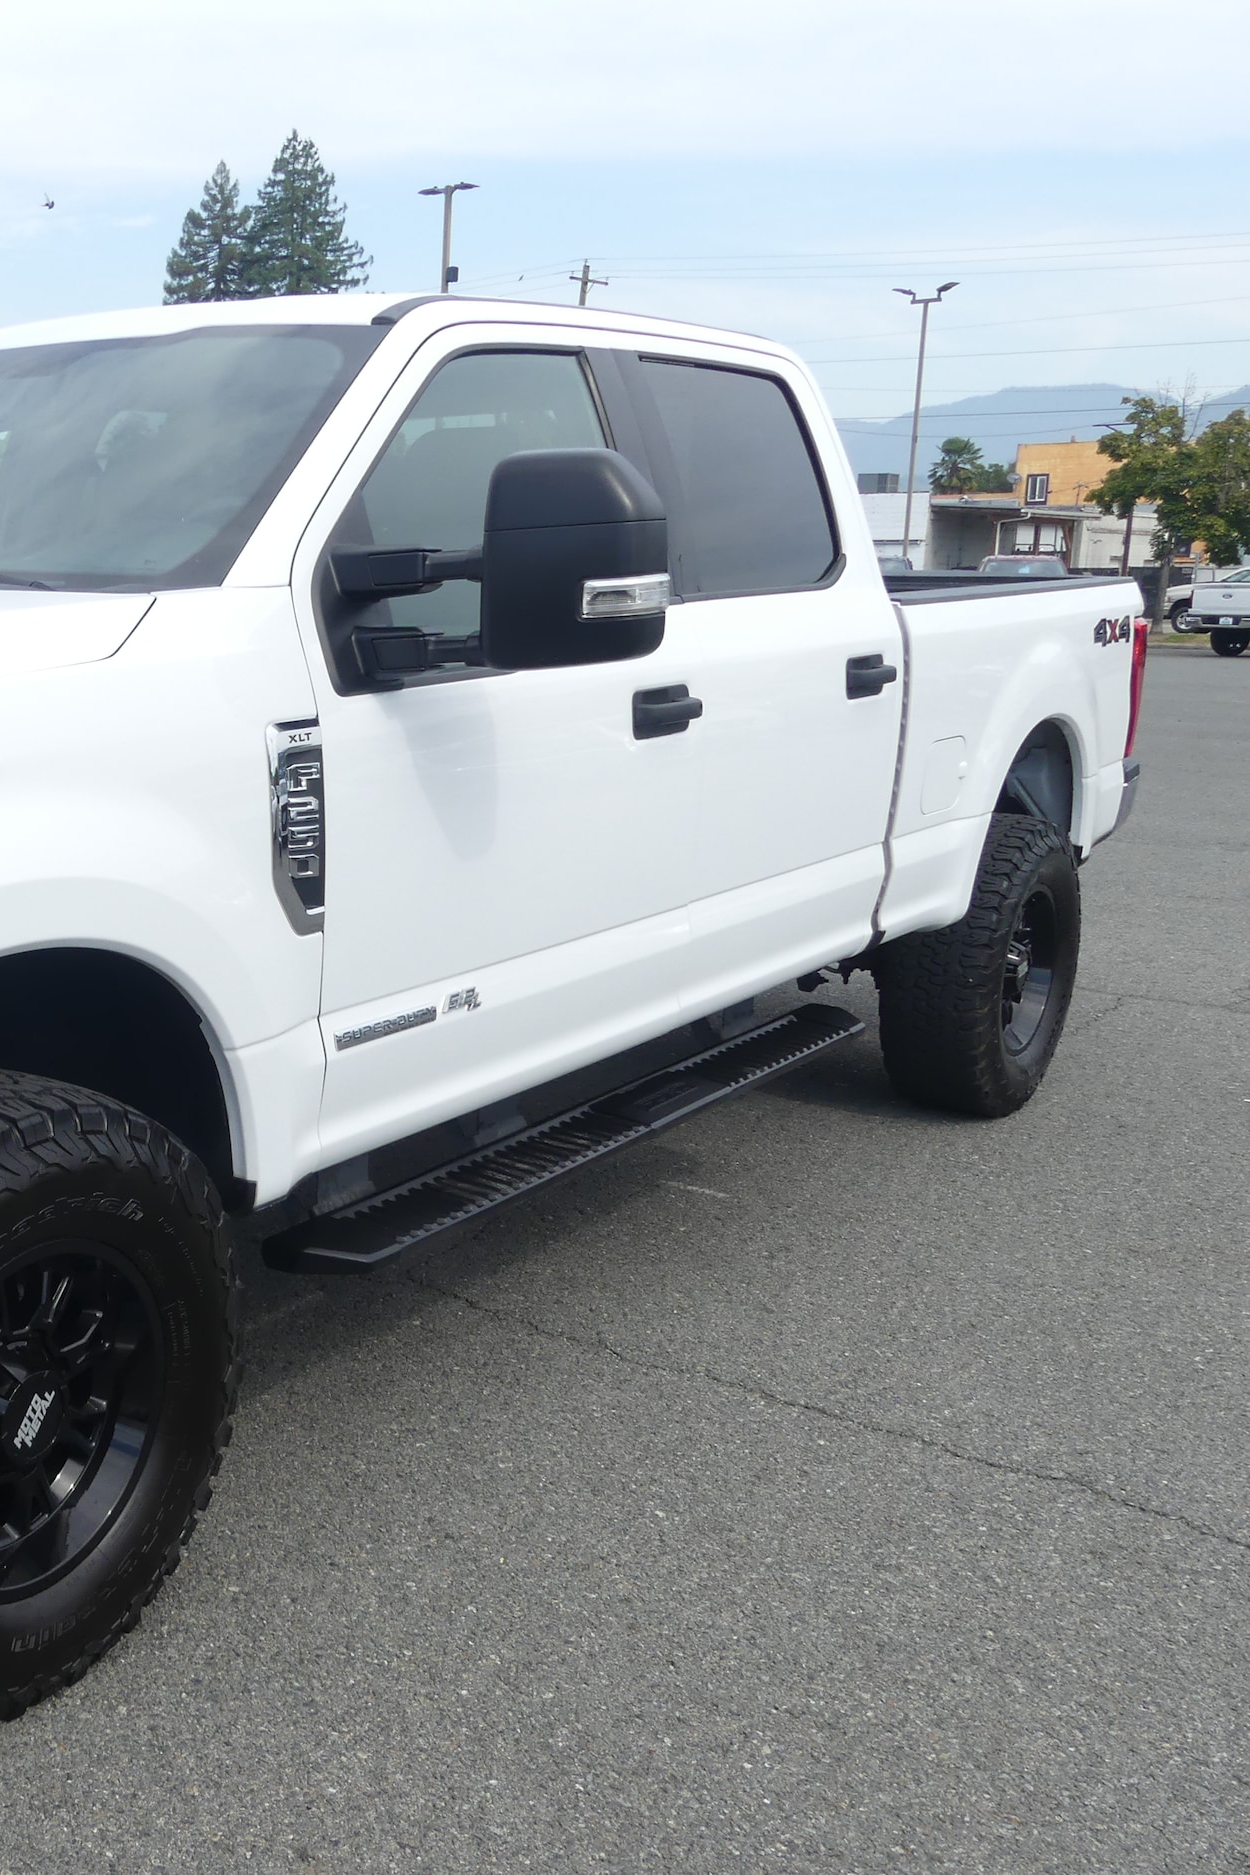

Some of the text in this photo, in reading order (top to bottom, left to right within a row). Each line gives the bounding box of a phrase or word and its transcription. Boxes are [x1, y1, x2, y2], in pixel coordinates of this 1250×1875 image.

[288, 732, 312, 744] XLT
[341, 1019, 395, 1044] SUPER
[396, 1006, 437, 1027] DUTY
[13, 1393, 42, 1450] MOTO
[23, 1390, 56, 1448] METAL
